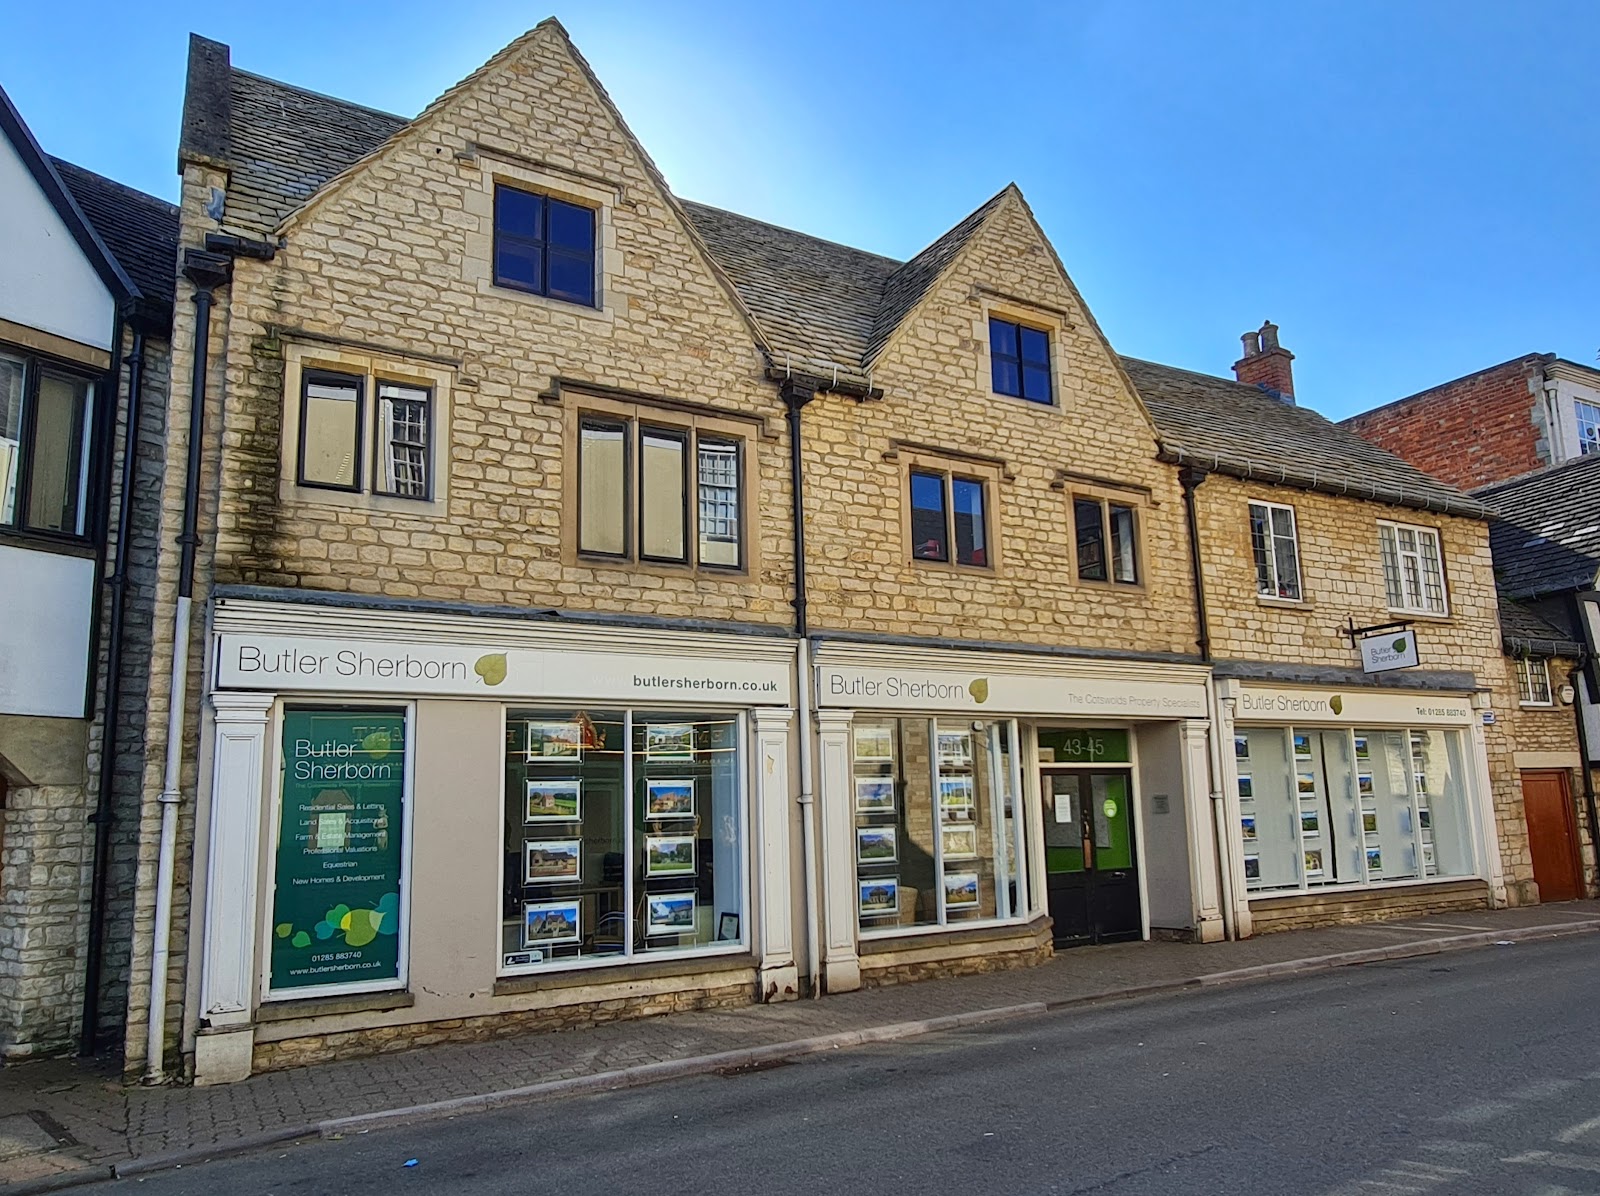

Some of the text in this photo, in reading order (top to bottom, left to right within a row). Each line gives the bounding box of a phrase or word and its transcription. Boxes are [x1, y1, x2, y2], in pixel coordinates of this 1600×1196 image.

[1370, 647, 1391, 656] Butler
[238, 645, 467, 680] Butler Sherborn
[1371, 653, 1406, 664] Sherborn
[633, 674, 778, 692] butlersherborn.co.uk
[830, 674, 964, 699] Butler Sherborn
[1068, 693, 1200, 709] The Cotswolds Property Specialists
[1242, 694, 1327, 713] Butler Sherborn
[1416, 707, 1426, 716] Tel:
[295, 739, 357, 758] Butler
[1063, 738, 1105, 755] 43-45
[294, 761, 391, 780] Sherborn
[337, 803, 354, 811] Sales
[295, 833, 313, 841] Farm
[344, 831, 386, 840] Management
[345, 846, 378, 854] Valuations
[322, 861, 358, 869] Equestrian
[292, 877, 308, 885] New
[310, 876, 334, 884] Homes
[343, 874, 386, 882] Development
[311, 951, 362, 962] 01285 883740
[289, 961, 382, 975] www.butlersherborn.co.uk
